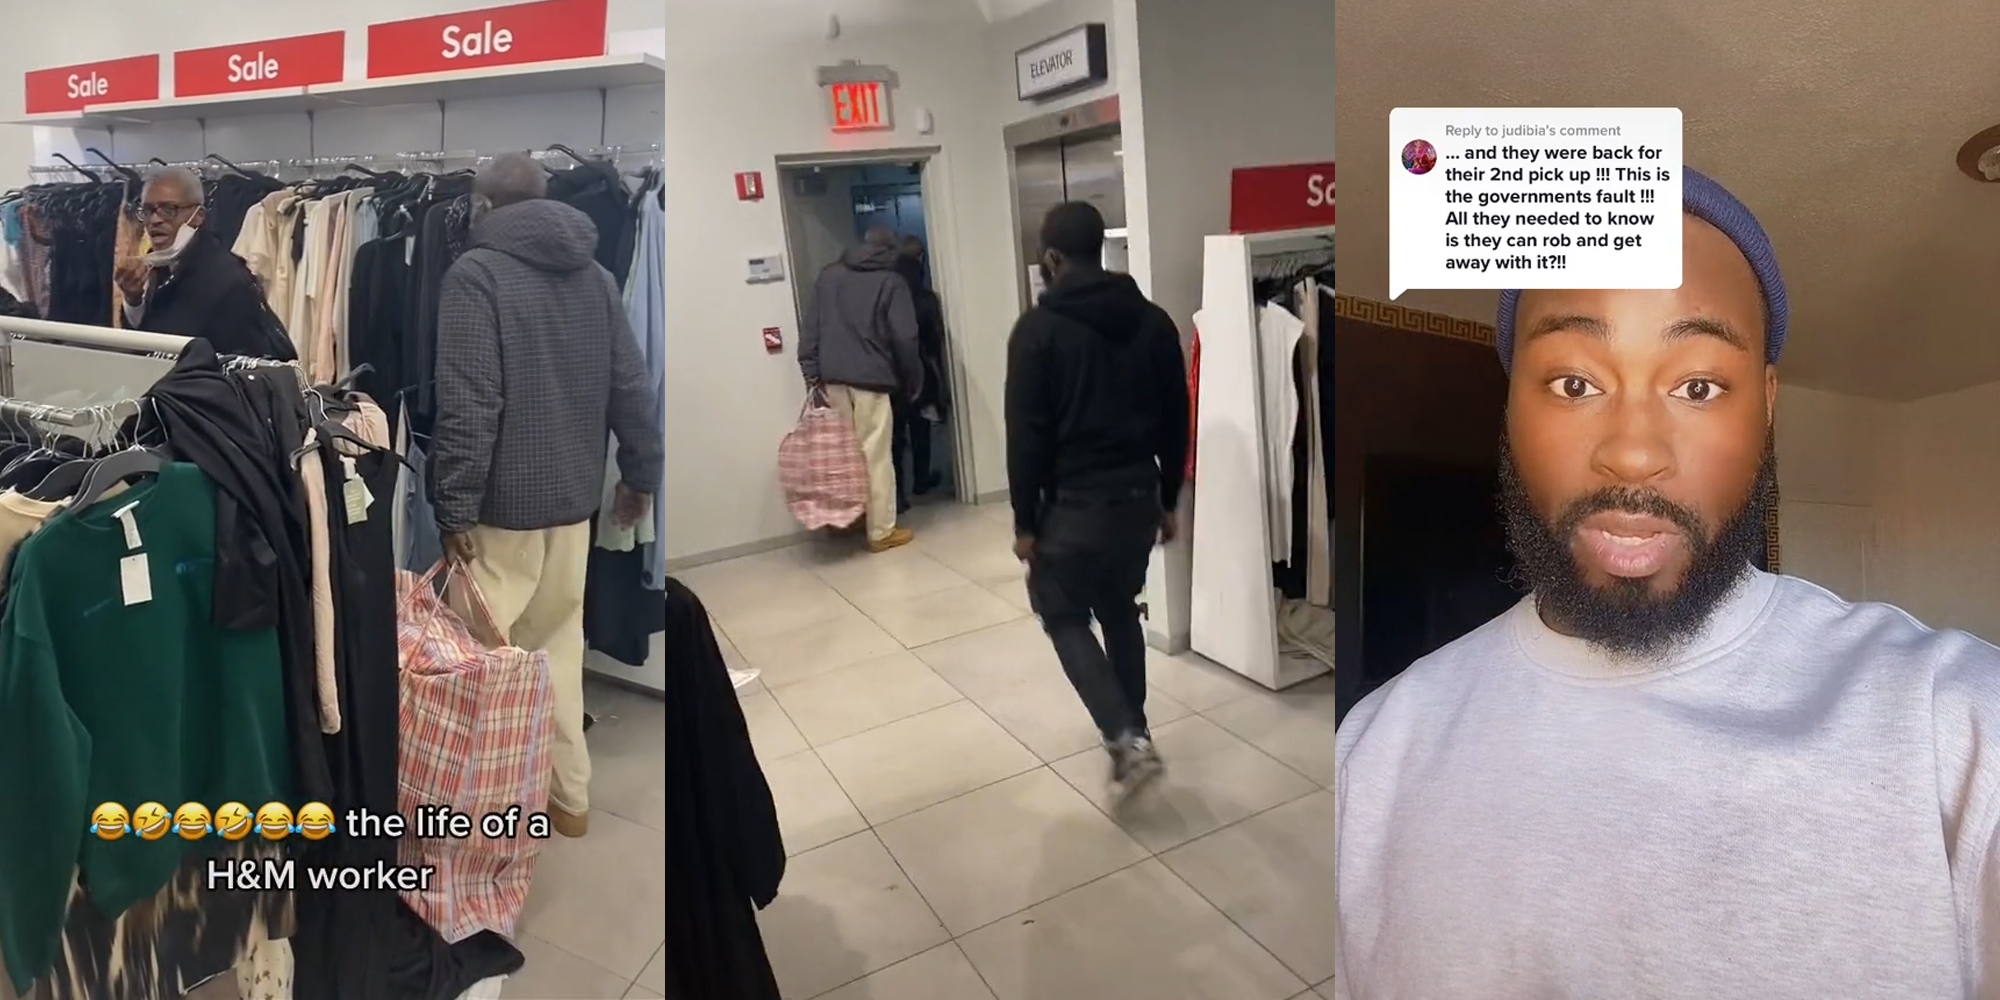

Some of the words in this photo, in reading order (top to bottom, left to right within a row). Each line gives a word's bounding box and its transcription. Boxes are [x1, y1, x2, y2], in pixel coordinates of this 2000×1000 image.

[441, 20, 513, 59] Sale
[227, 50, 279, 83] Sale
[1030, 49, 1073, 79] ELEVATOR
[67, 72, 109, 99] Sale
[832, 82, 880, 125] EXIT
